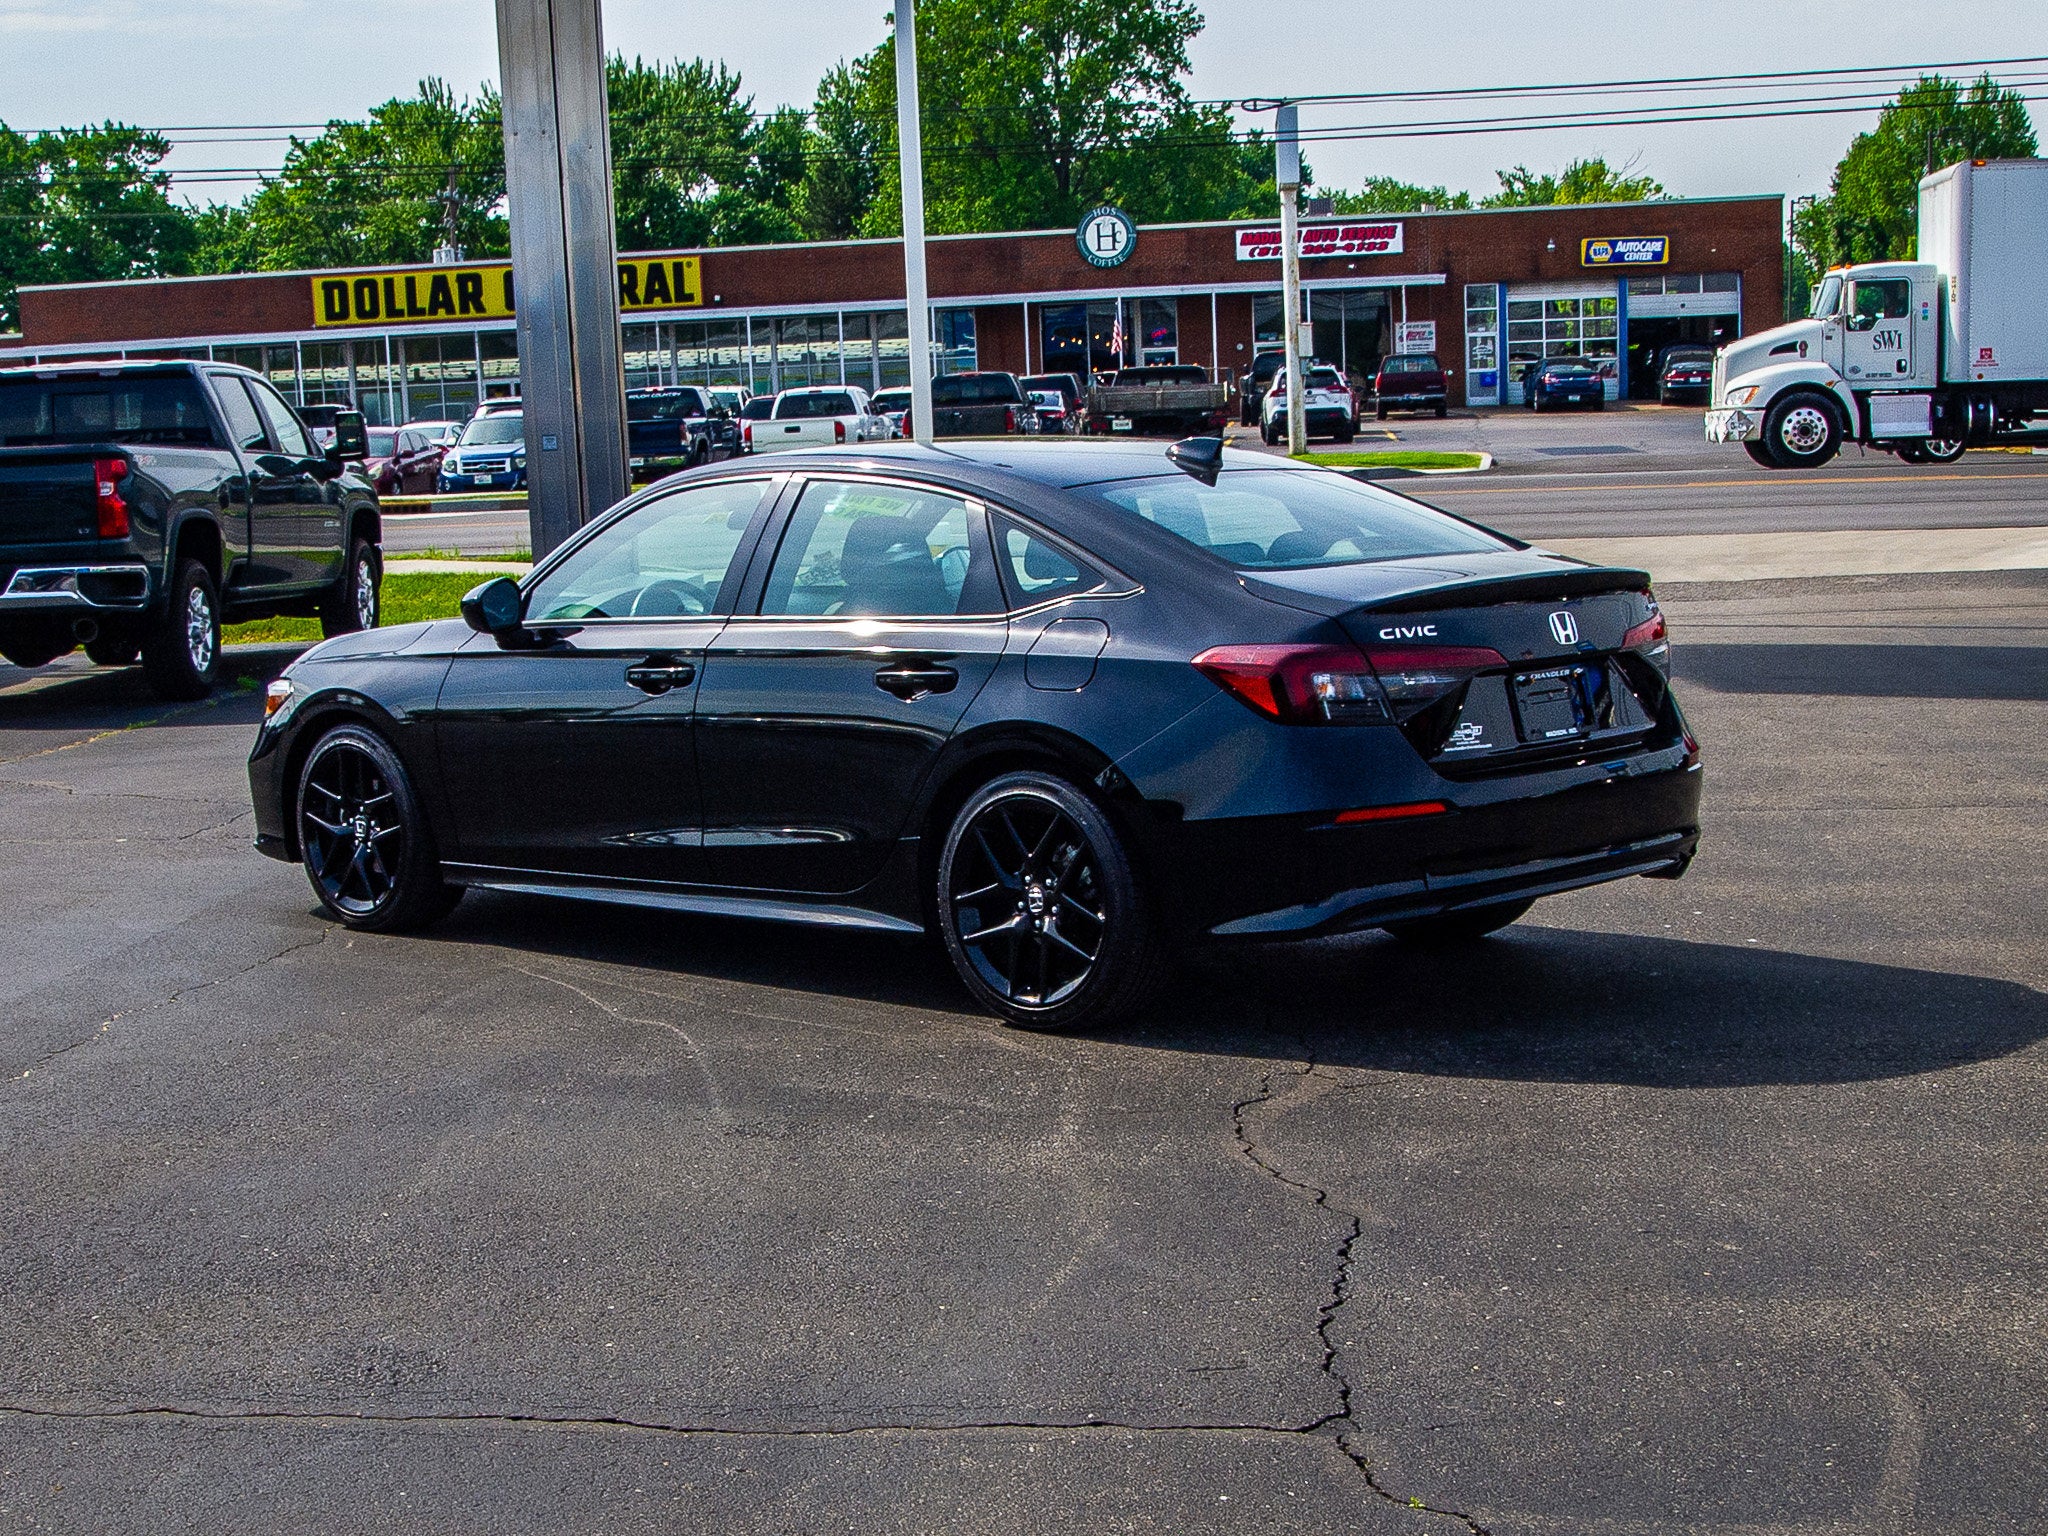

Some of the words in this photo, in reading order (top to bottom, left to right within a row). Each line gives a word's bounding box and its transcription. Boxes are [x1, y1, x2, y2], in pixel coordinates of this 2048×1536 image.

[1092, 206, 1117, 217] HOS
[1303, 228, 1340, 243] AUTO
[1339, 225, 1398, 241] SERVICE
[1087, 254, 1127, 267] COFFEE
[1624, 252, 1653, 261] CENTER
[320, 273, 487, 322] DOLLAR
[1379, 625, 1438, 639] CIVIC
[1530, 669, 1571, 679] CHANDLER
